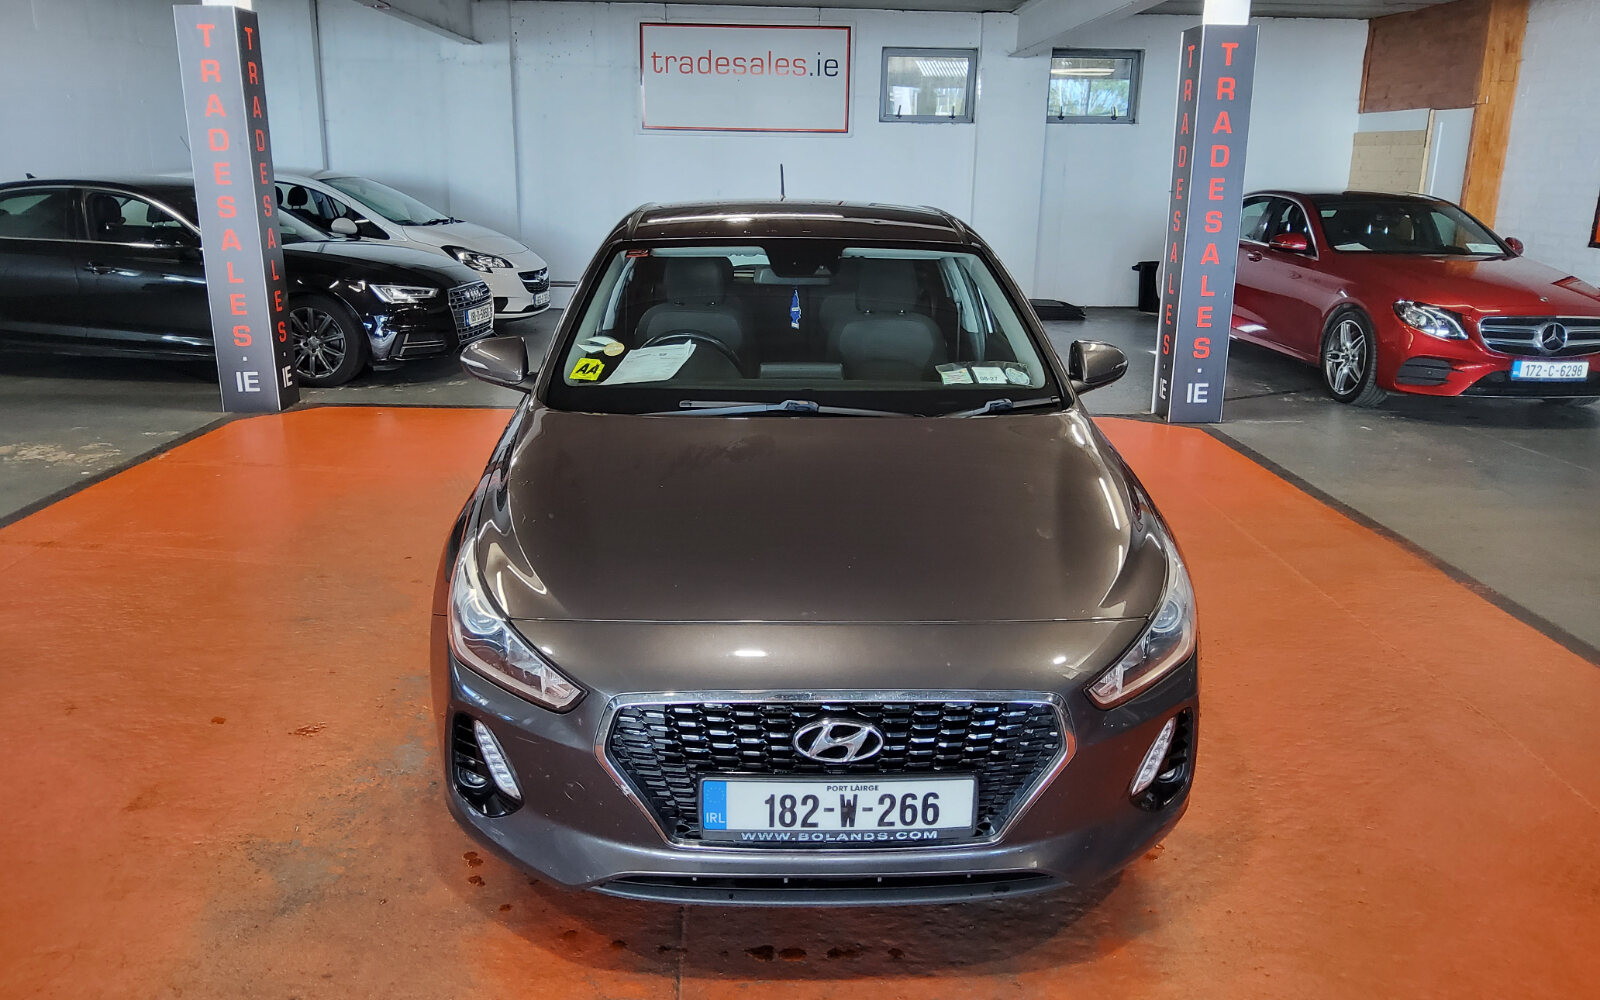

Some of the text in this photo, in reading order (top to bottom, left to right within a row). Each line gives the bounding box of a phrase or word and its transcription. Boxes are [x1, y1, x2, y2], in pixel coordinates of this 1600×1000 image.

[650, 49, 839, 77] tradesales.ie
[576, 363, 600, 375] AA
[1526, 364, 1583, 377] 172-C-6298
[764, 792, 940, 828] 182-W-266
[705, 812, 726, 823] IRL
[740, 830, 938, 841] WWW.BOLANDS.COM
